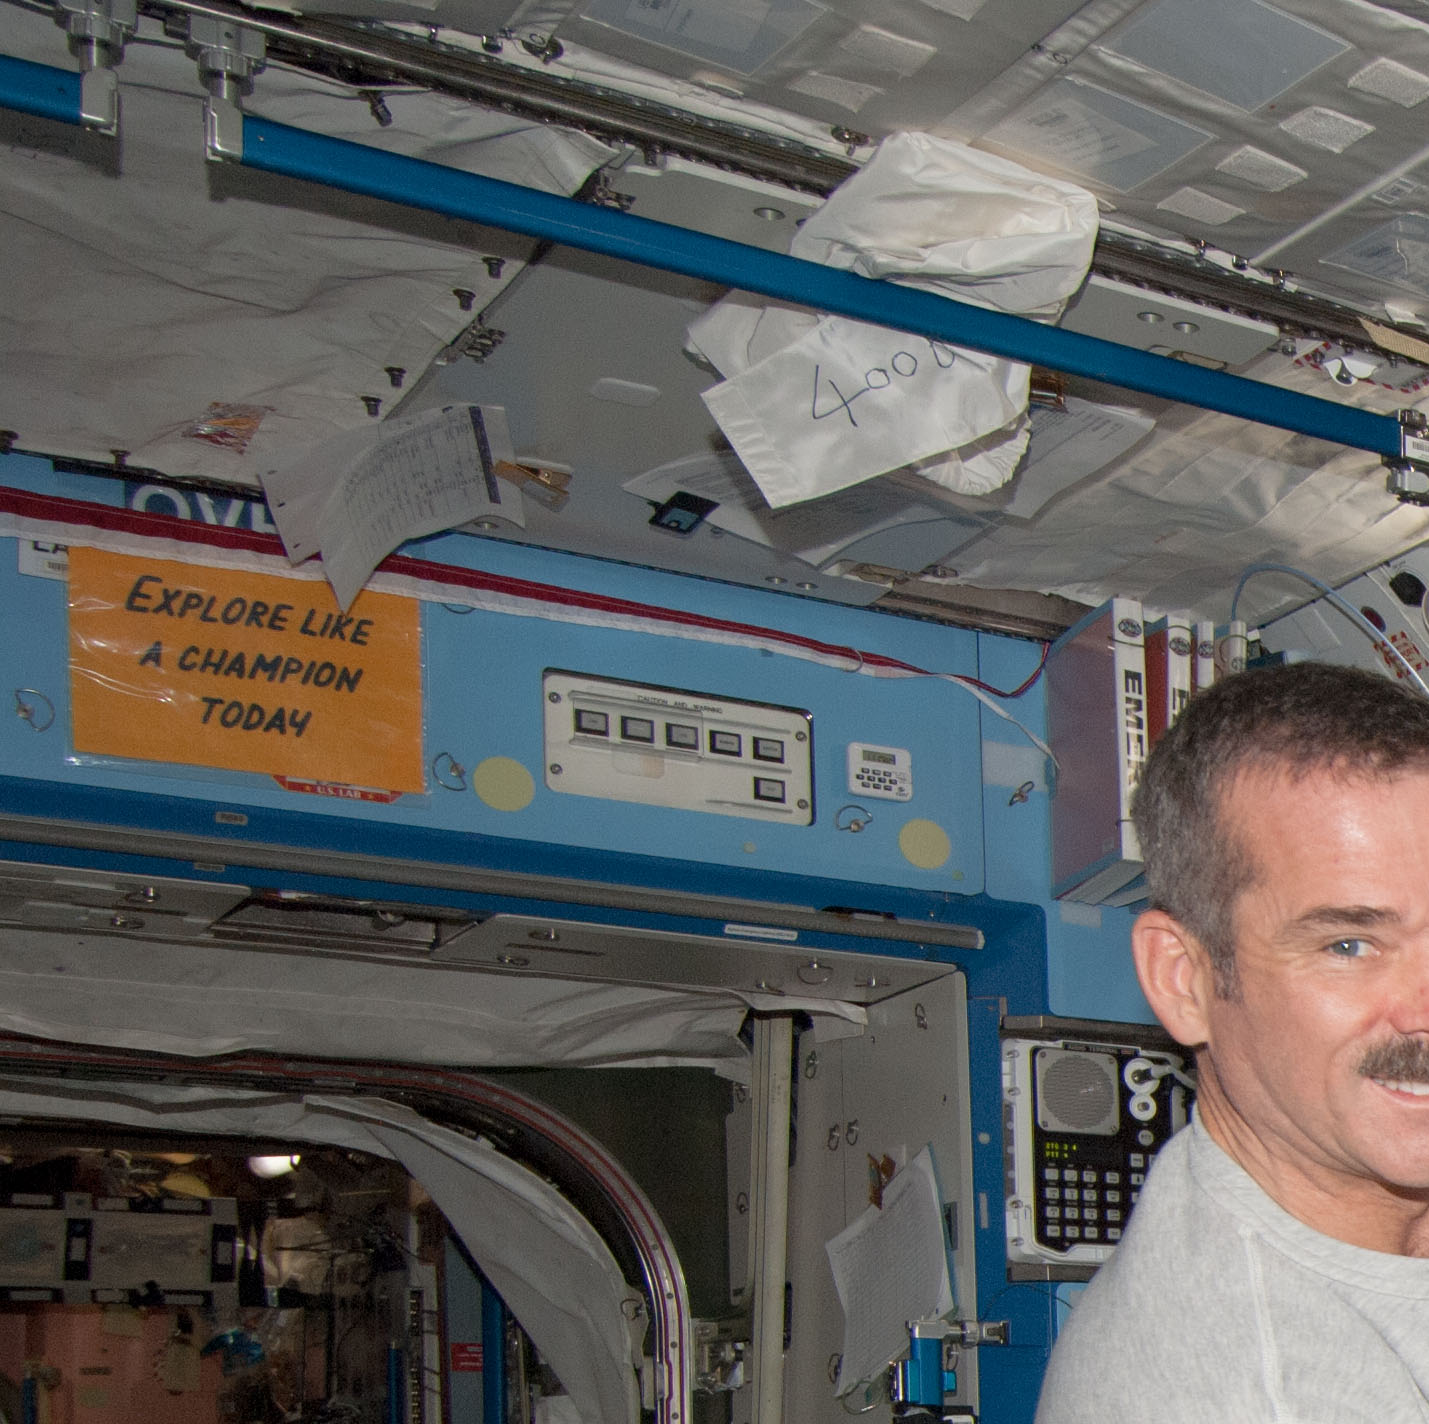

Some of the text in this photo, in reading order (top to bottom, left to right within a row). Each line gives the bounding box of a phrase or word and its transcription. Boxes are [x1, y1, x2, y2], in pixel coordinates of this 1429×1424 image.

[125, 575, 374, 646] EXPLORE LIKE
[139, 641, 363, 693] A CHAMPION
[201, 697, 313, 738] TODAY
